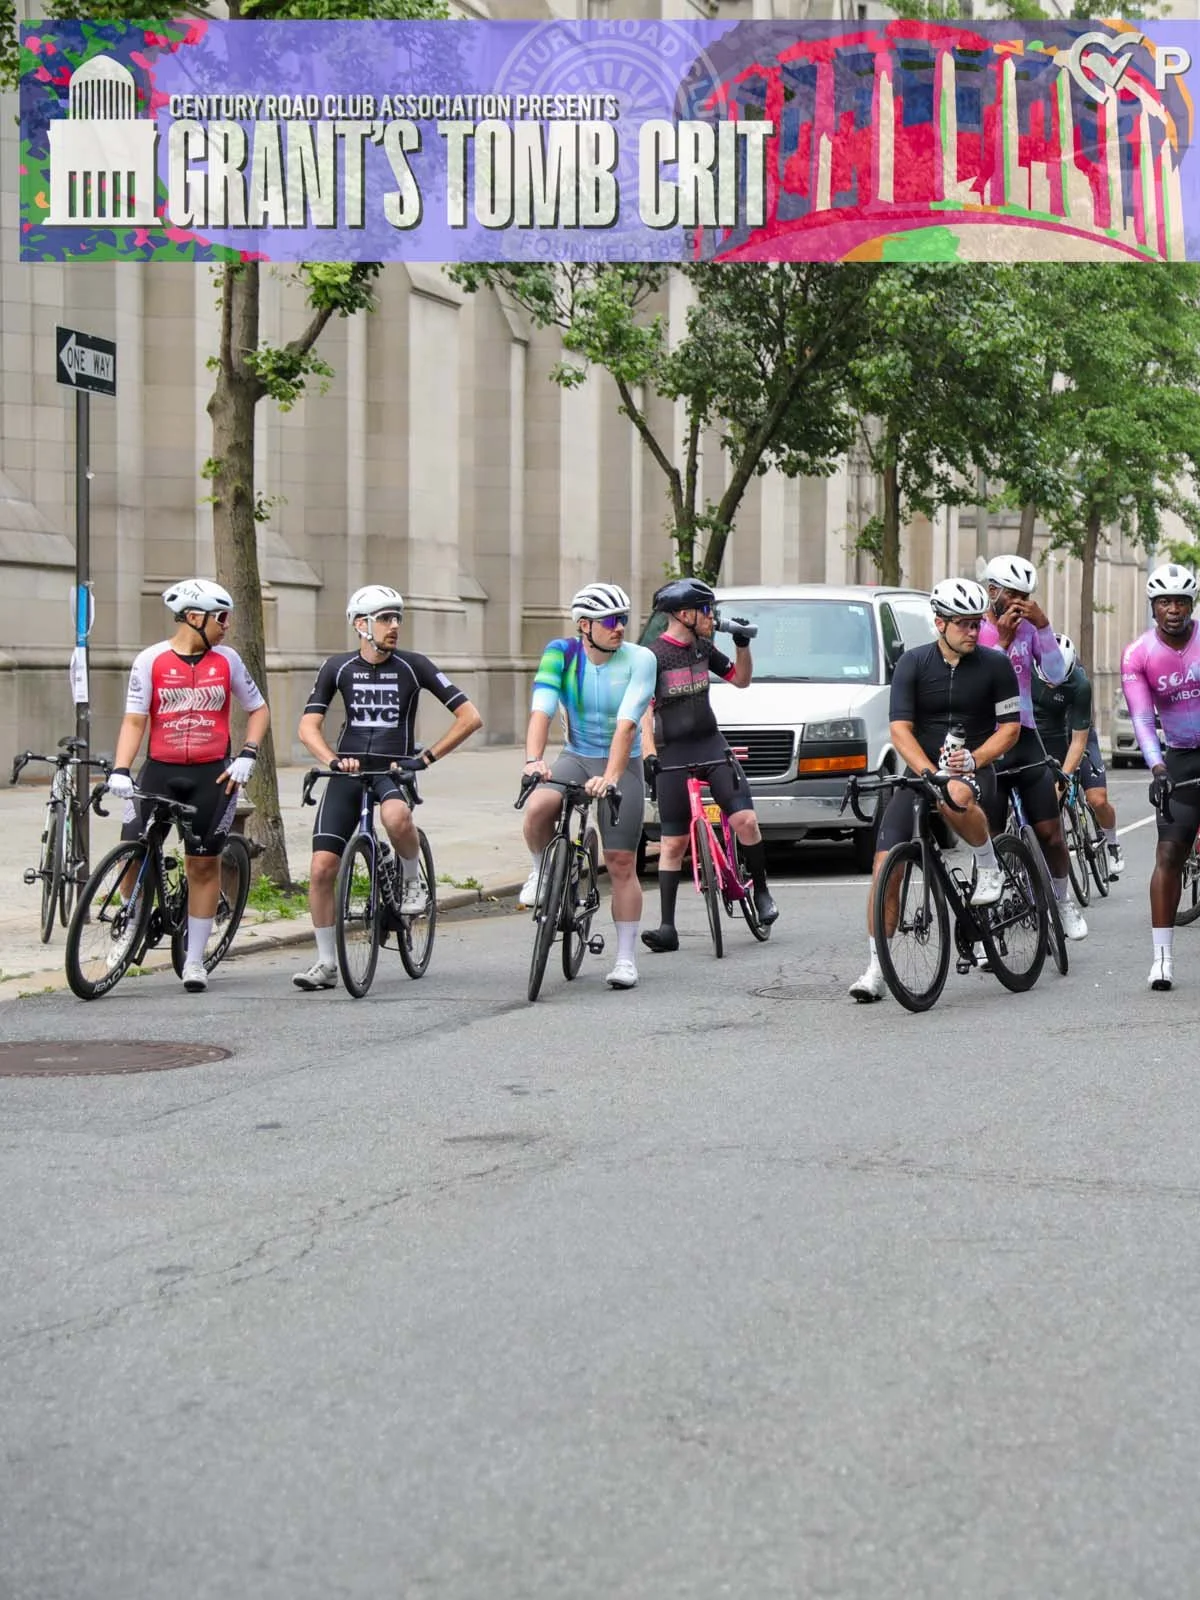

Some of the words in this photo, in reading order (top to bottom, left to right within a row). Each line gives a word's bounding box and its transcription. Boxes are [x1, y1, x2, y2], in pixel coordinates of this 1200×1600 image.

[66, 346, 86, 371] ONE
[93, 350, 112, 378] WAY
[352, 672, 370, 680] NYC
[668, 680, 708, 695] CYCLING
[350, 707, 400, 723] NYC
